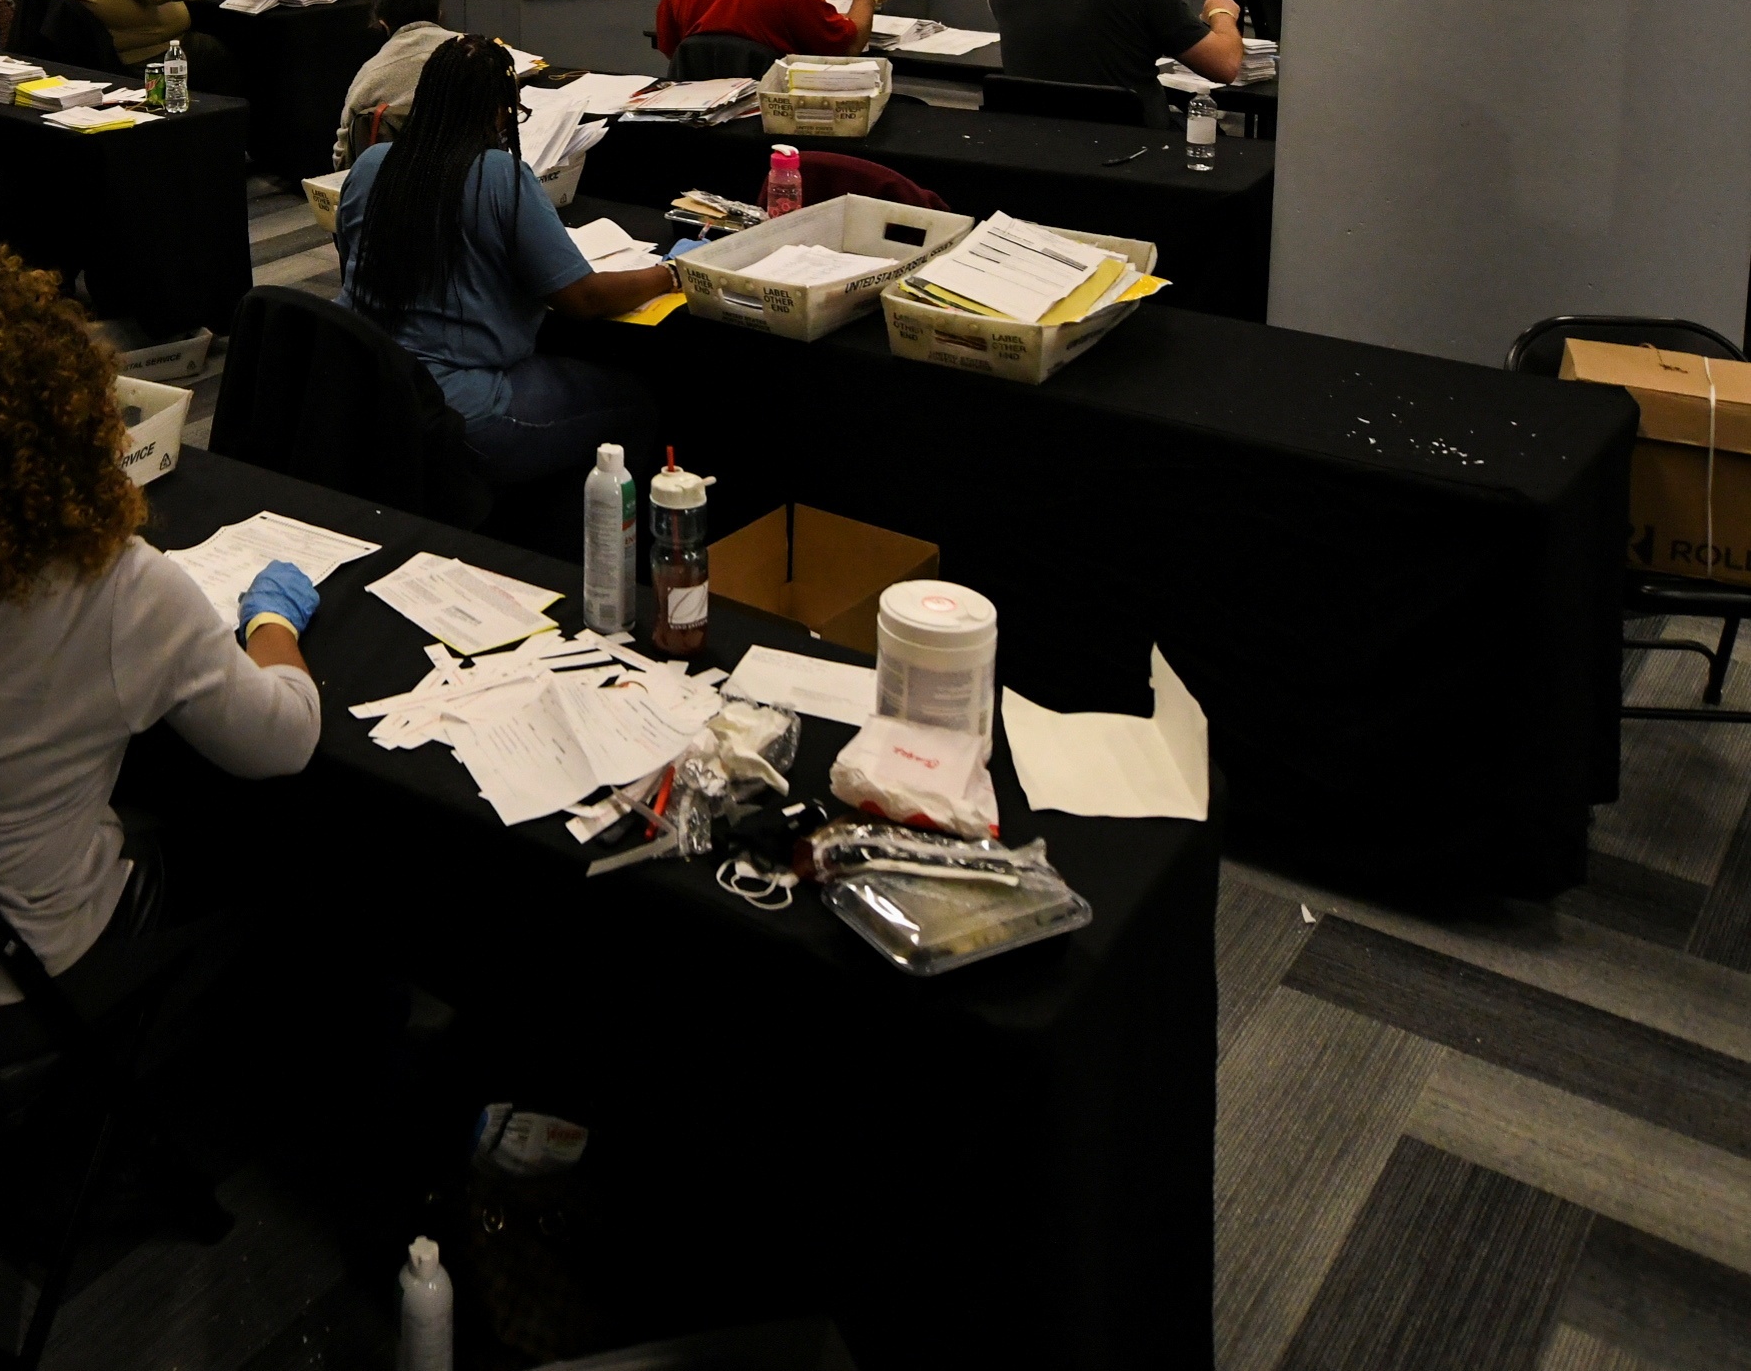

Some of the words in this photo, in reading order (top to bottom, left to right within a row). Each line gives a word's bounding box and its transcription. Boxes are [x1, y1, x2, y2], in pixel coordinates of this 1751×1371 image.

[768, 97, 792, 105] LABEL
[768, 103, 794, 111] OTHER
[311, 189, 329, 200] LABEL
[686, 268, 711, 282] LABEL
[844, 275, 875, 293] UNITED
[875, 265, 905, 285] STATES
[904, 254, 928, 274] POSTAL
[687, 276, 714, 289] OTHER
[694, 284, 710, 295] END
[763, 287, 792, 299] LABEL
[764, 296, 794, 307] OTHER
[771, 304, 790, 313] END
[900, 331, 919, 341] END
[992, 333, 1024, 344] LABEL
[991, 342, 1027, 353] OTHER
[145, 352, 182, 367] SERVICE
[999, 351, 1020, 360] END
[121, 441, 156, 468] RVICE
[1671, 540, 1751, 572] ROL
